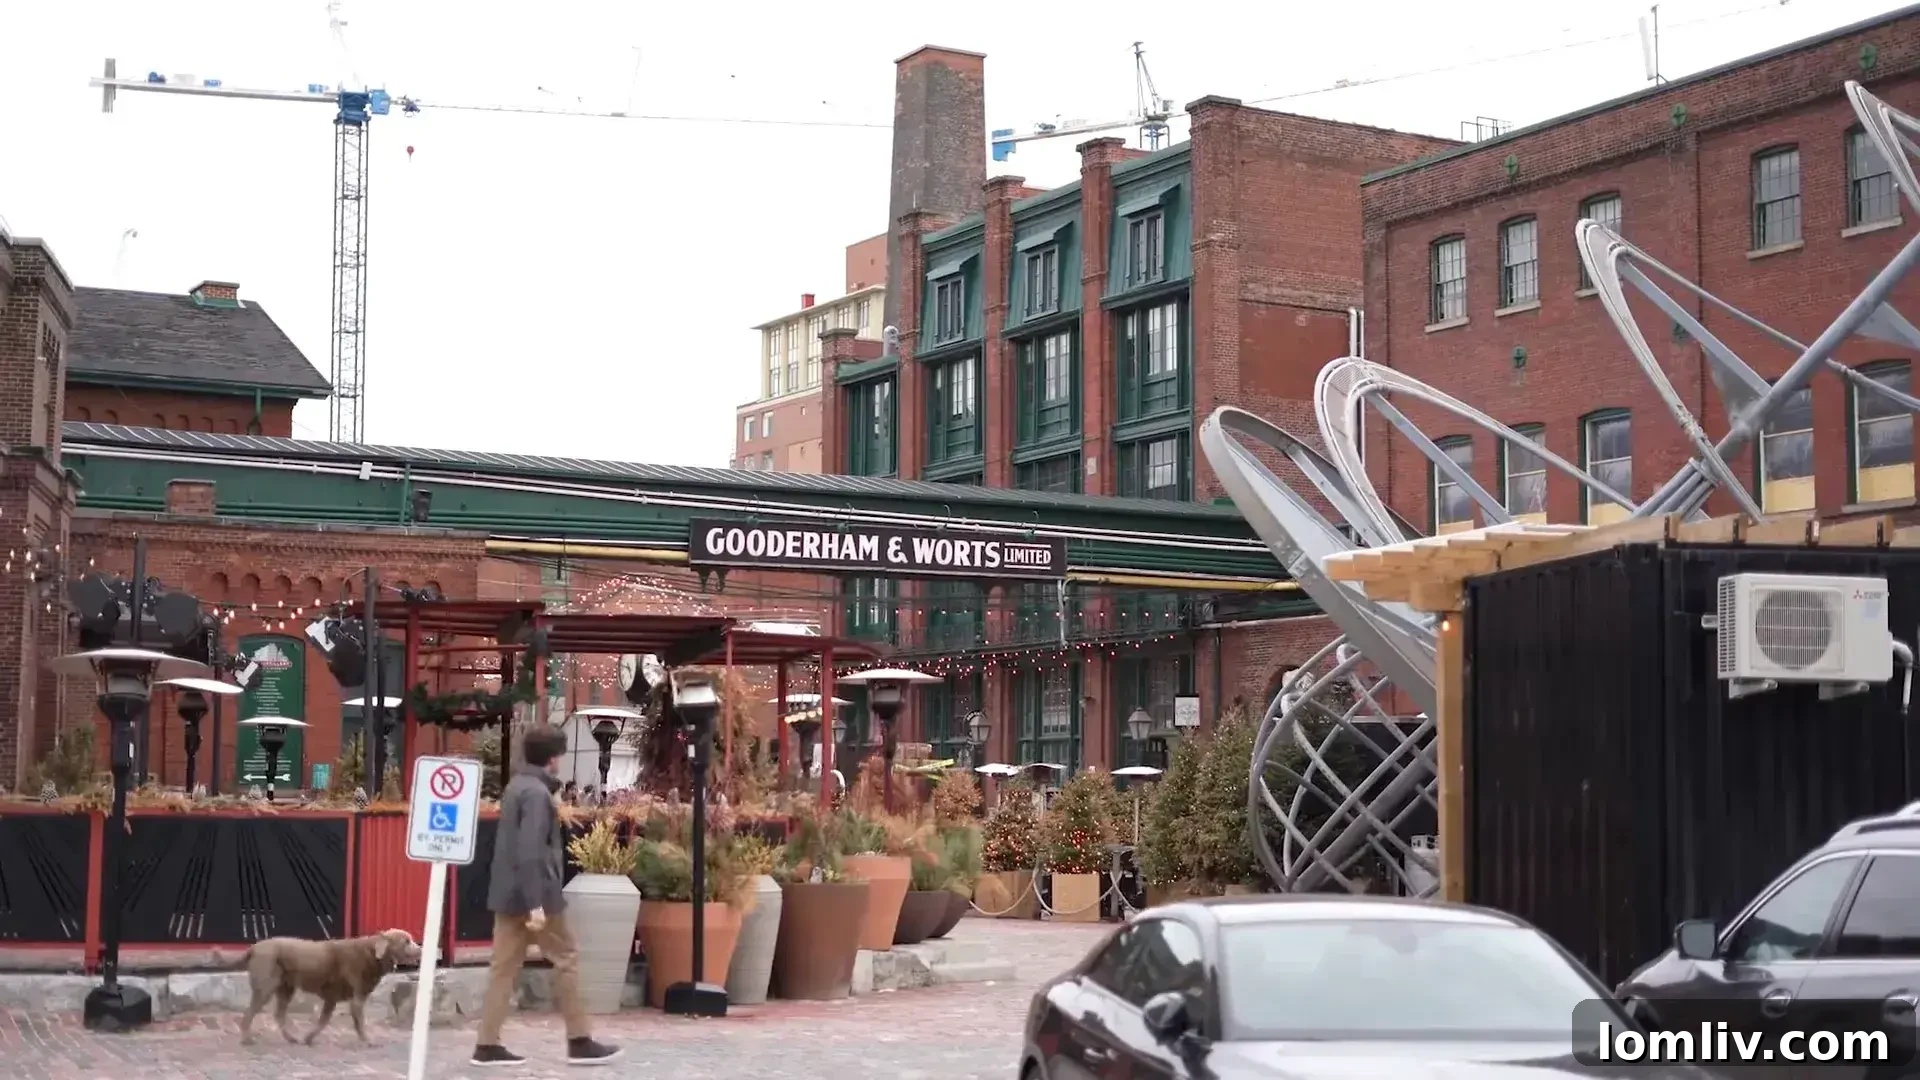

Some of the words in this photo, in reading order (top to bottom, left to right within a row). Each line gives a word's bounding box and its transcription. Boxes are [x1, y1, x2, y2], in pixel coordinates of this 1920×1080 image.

[705, 527, 880, 561] GOODERHAM
[886, 536, 909, 564] &
[911, 538, 1001, 569] WORTS
[1003, 546, 1052, 567] LIMITED
[428, 843, 453, 853] ONLY
